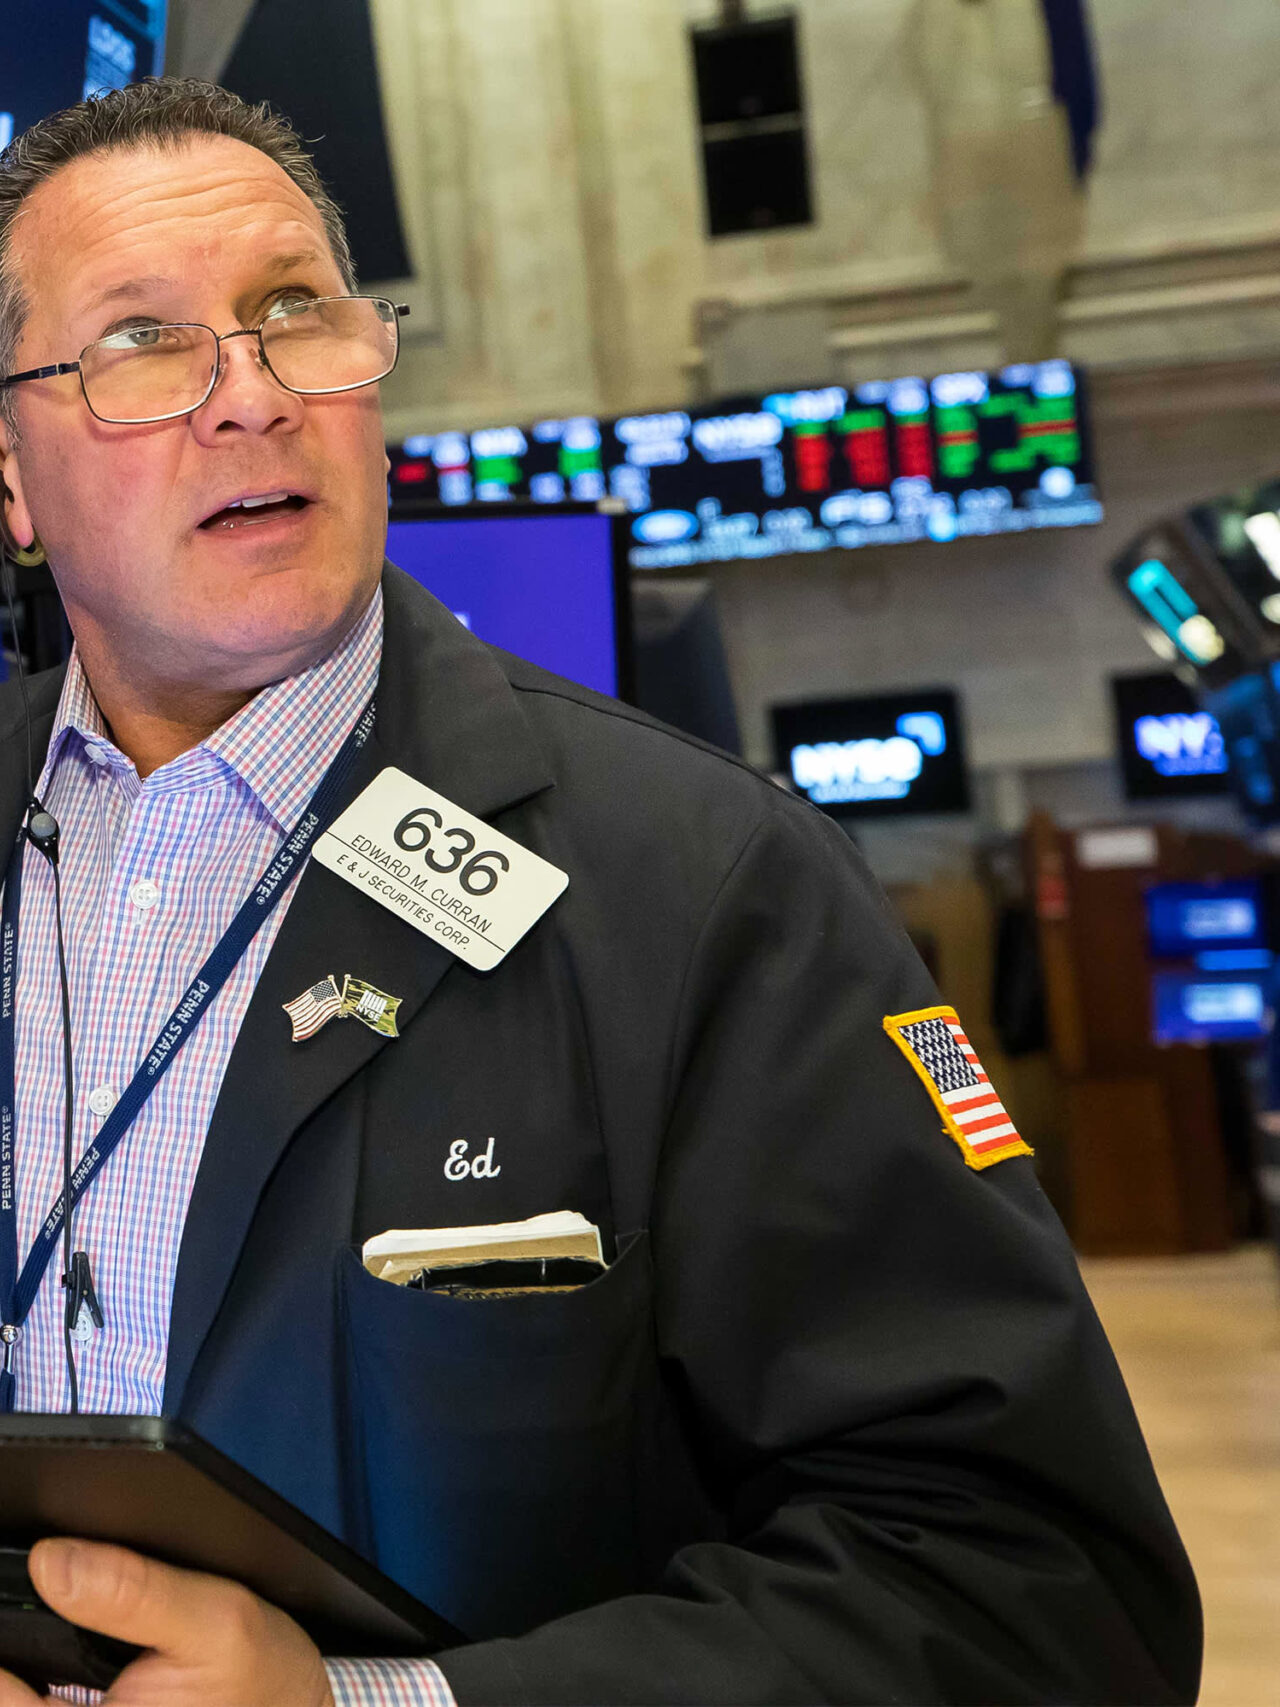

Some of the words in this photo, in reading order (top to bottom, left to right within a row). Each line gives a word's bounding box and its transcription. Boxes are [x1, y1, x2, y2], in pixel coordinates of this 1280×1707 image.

[287, 812, 320, 855] PENN
[393, 807, 510, 896] 636
[336, 854, 349, 865] E
[347, 862, 357, 873] &
[358, 869, 369, 879] J
[368, 876, 434, 924] SECURITIES
[434, 921, 470, 950] CORP.
[350, 834, 411, 879] EDWARD
[410, 874, 427, 893] M.
[430, 888, 493, 933] CURRAN
[2, 977, 12, 1018] PENN
[175, 979, 210, 1024] PENN
[355, 1003, 382, 1022] NYSE
[71, 1147, 101, 1190] PENN
[443, 1136, 501, 1181] Ed
[2, 1165, 12, 1210] PENN
